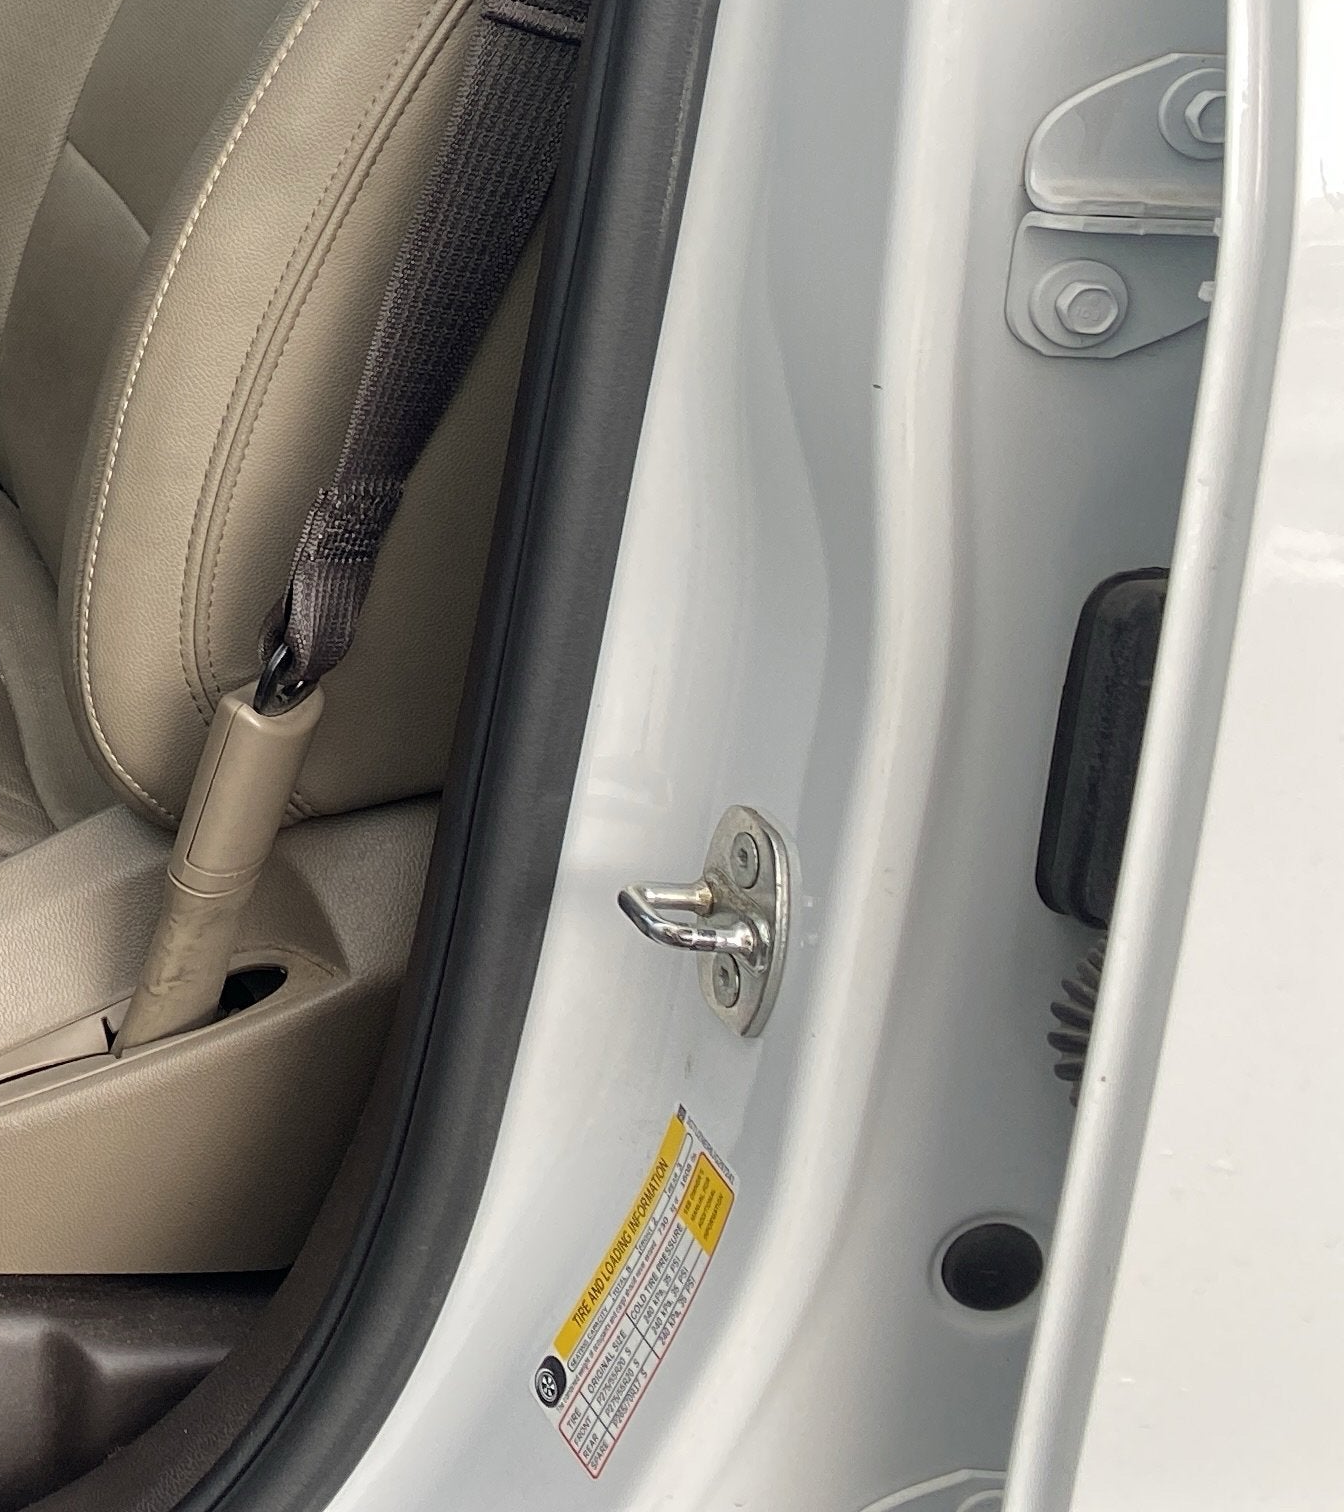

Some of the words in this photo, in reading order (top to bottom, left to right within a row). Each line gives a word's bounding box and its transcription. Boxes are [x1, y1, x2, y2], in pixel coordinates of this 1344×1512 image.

[566, 1406, 581, 1431] TIRE
[586, 1346, 616, 1396] ORIGINAL
[612, 1327, 627, 1352] SIZE
[629, 1290, 647, 1322] COLD
[644, 1270, 658, 1296] TIRE
[655, 1221, 683, 1275] PRESSURE
[571, 1297, 591, 1331] TIRE
[586, 1274, 606, 1305] AND
[600, 1227, 632, 1282] LOADING
[627, 1154, 668, 1235] INFORMATION
[586, 1305, 608, 1341] CAPACITY
[573, 1415, 591, 1446] FRONT
[669, 1254, 680, 1274] PSI
[582, 1432, 599, 1460] REAR
[677, 1265, 689, 1285] PSI
[590, 1438, 609, 1472] SPARE
